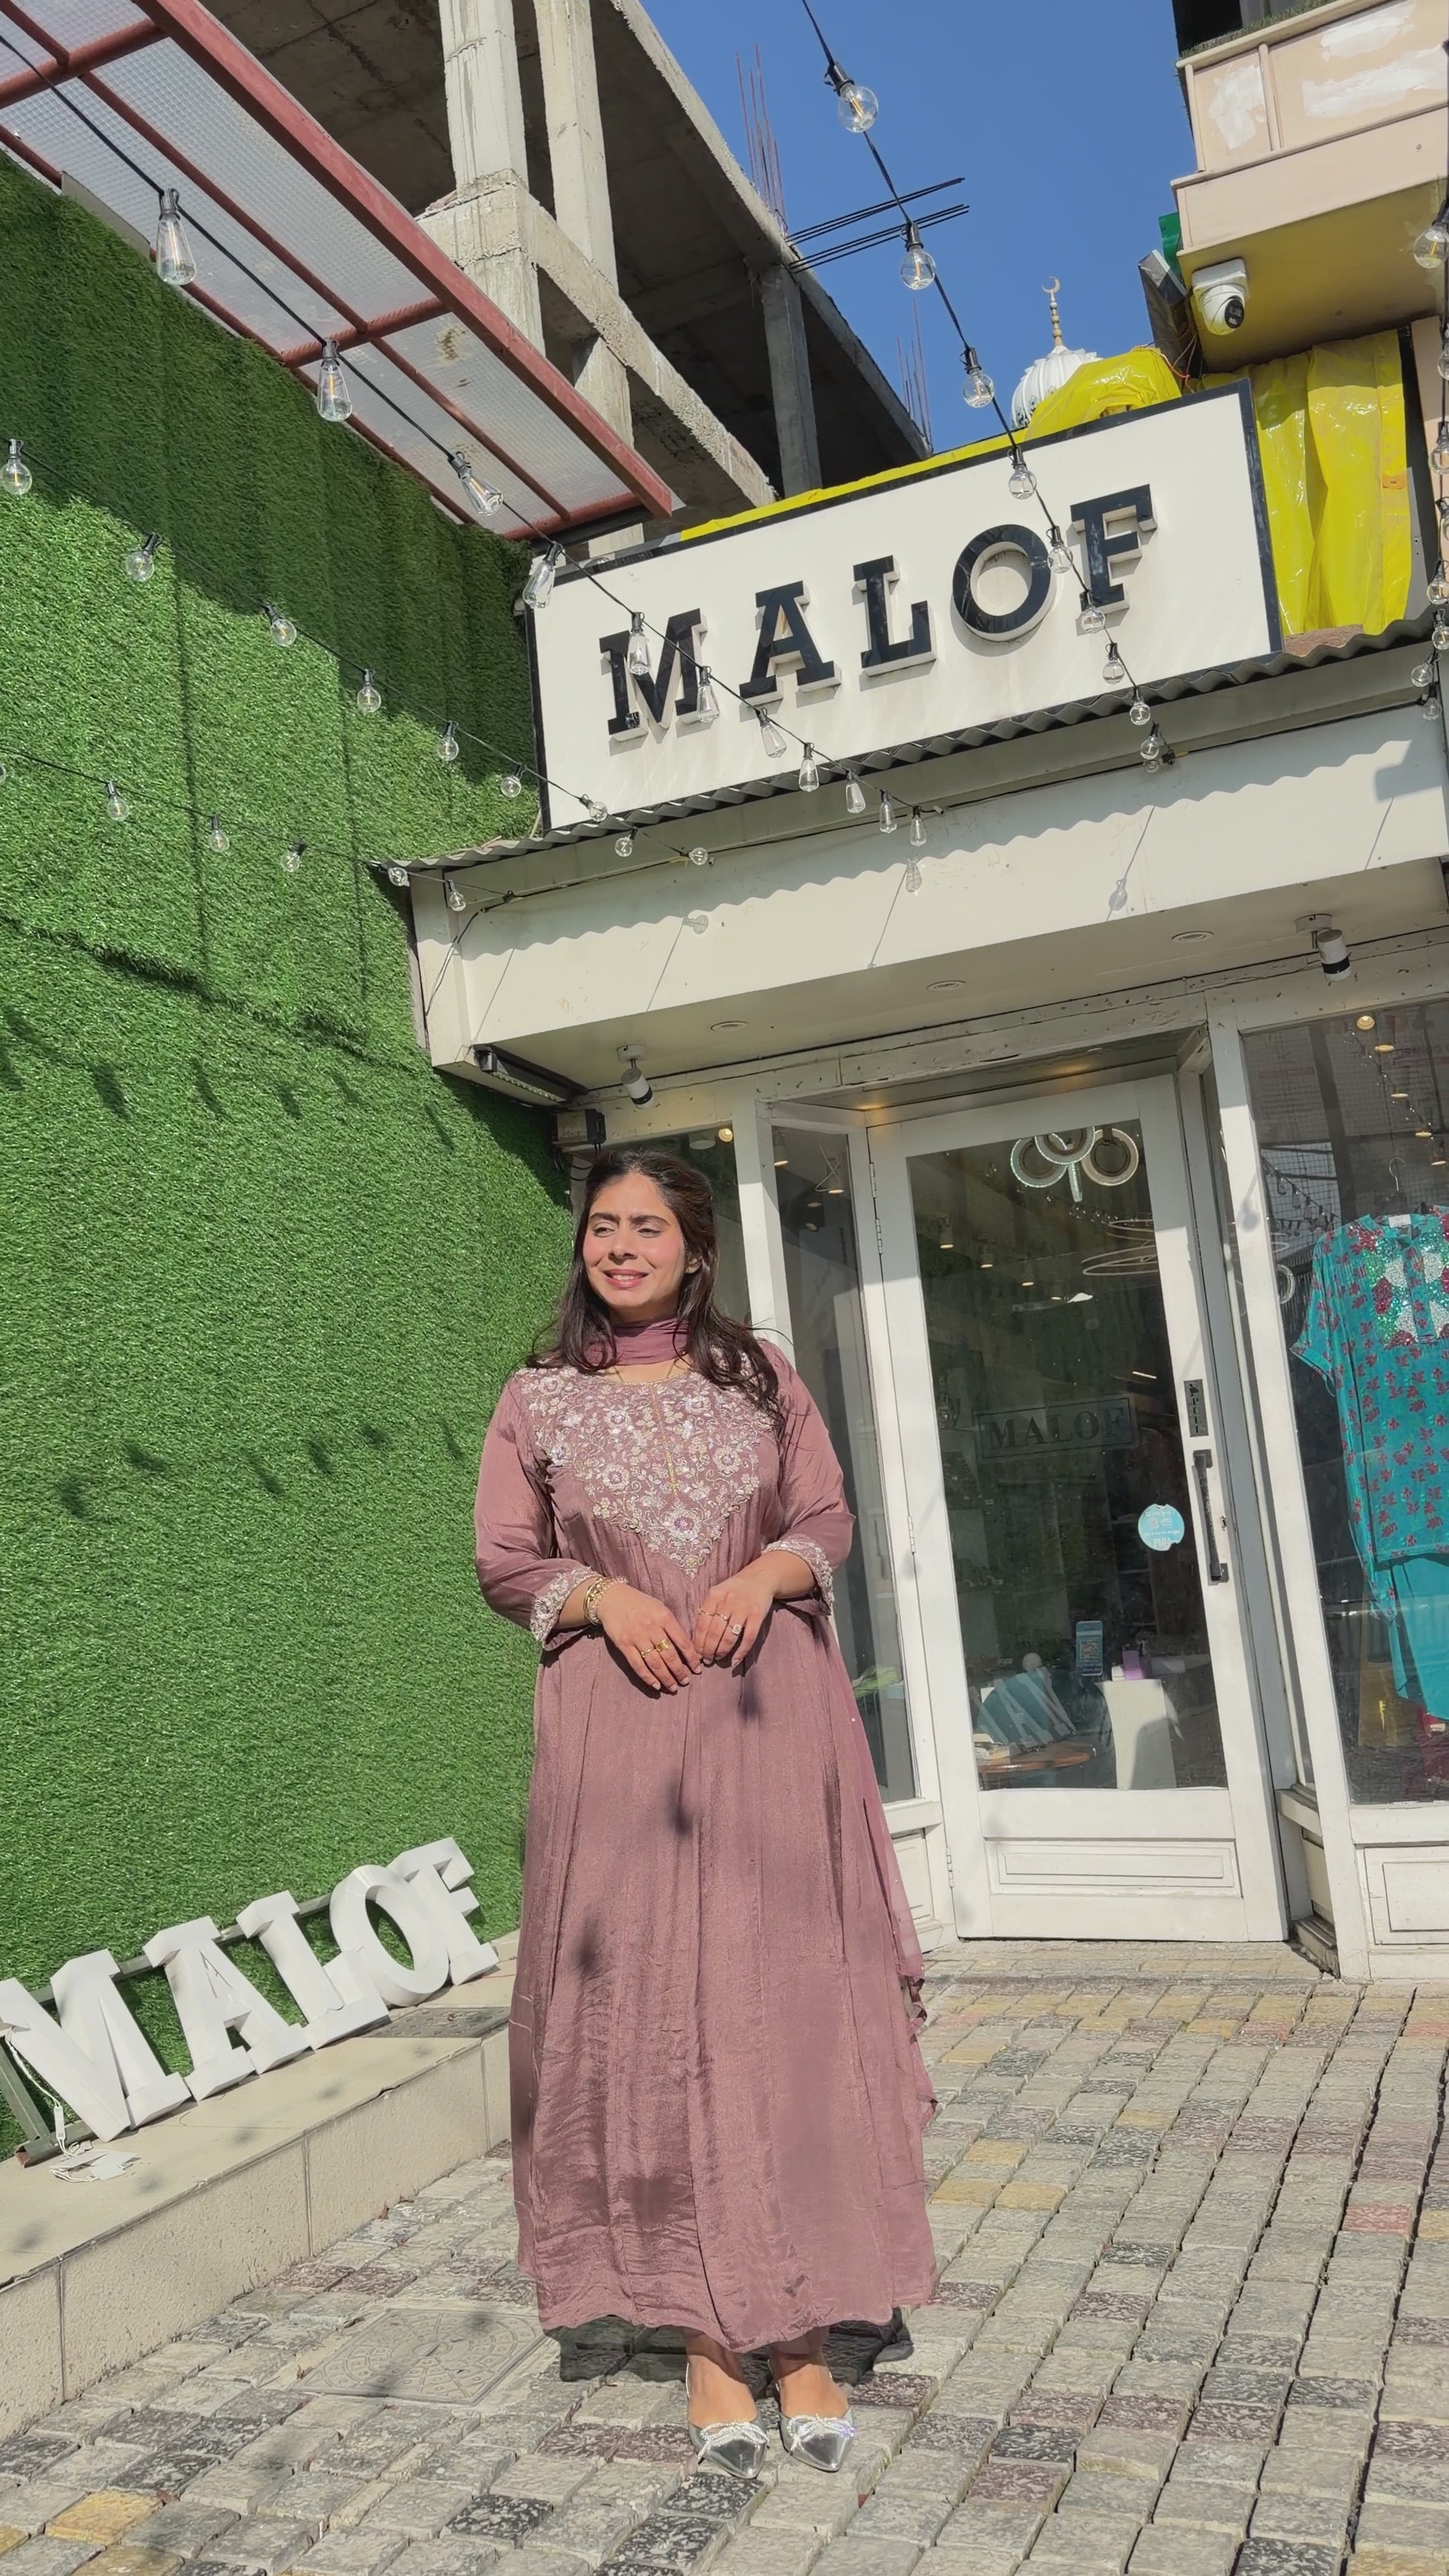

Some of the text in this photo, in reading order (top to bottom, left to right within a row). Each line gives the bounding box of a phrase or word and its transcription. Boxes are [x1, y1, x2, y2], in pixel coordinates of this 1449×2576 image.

[599, 484, 1158, 742] MALOF
[988, 1407, 1126, 1450] MALOF
[0, 1837, 499, 2142] MALOF
